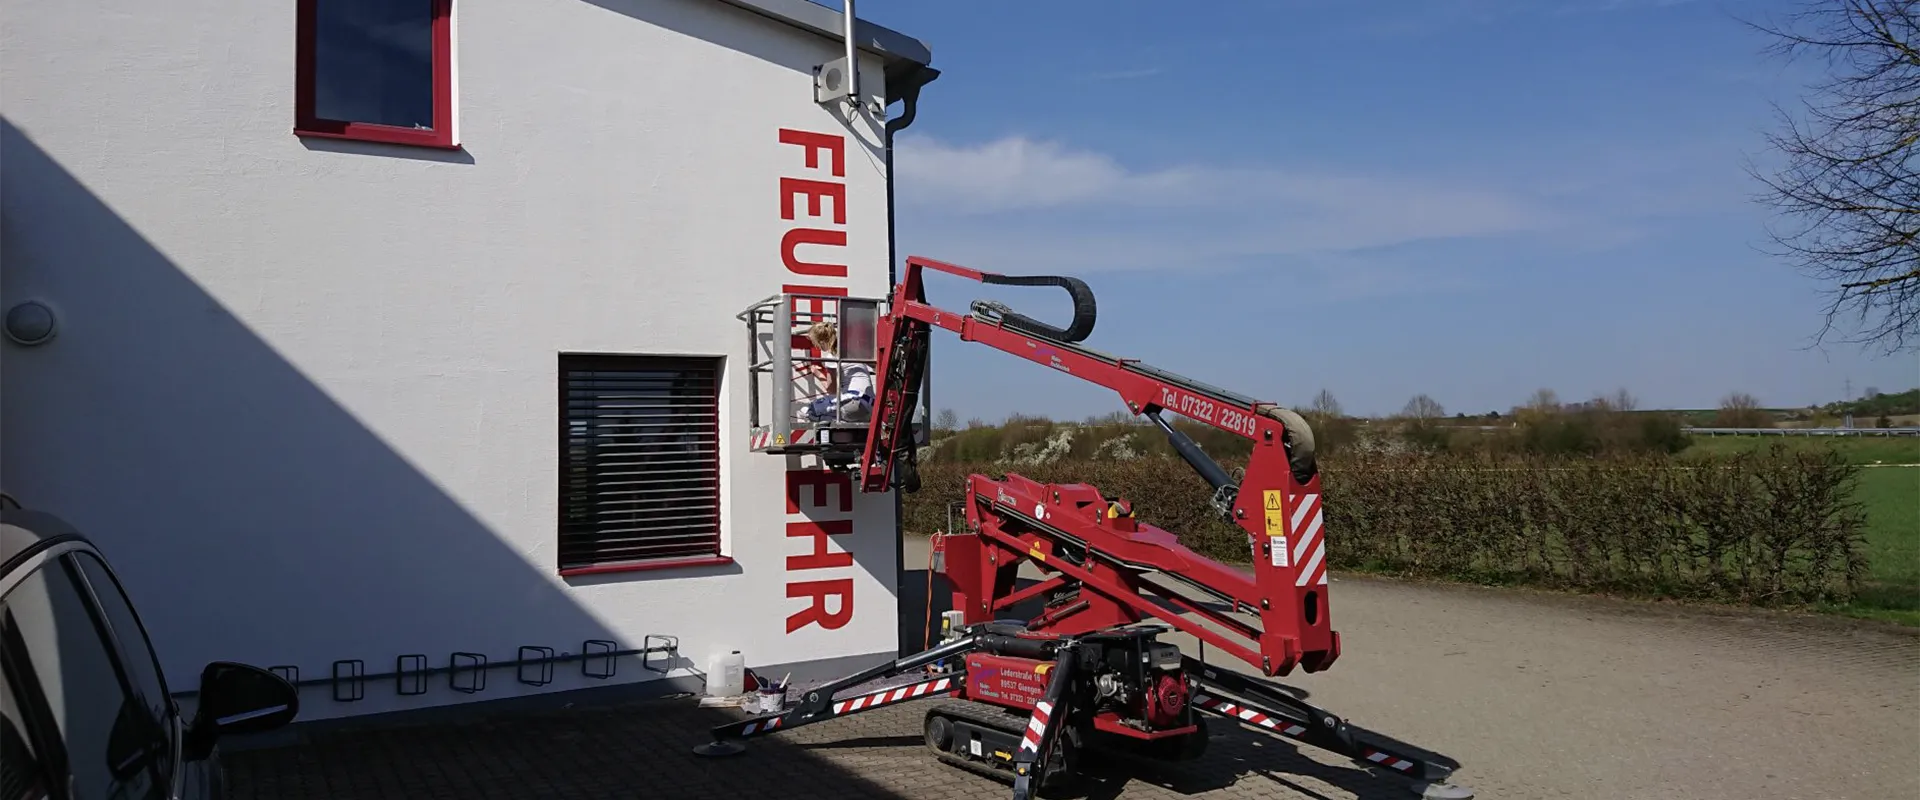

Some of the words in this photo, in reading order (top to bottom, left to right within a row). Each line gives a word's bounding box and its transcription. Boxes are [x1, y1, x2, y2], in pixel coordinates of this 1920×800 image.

[1162, 388, 1178, 409] Tel.
[1181, 395, 1213, 421] 07322
[1220, 408, 1256, 436] 22819
[1018, 682, 1041, 696] Giengen
